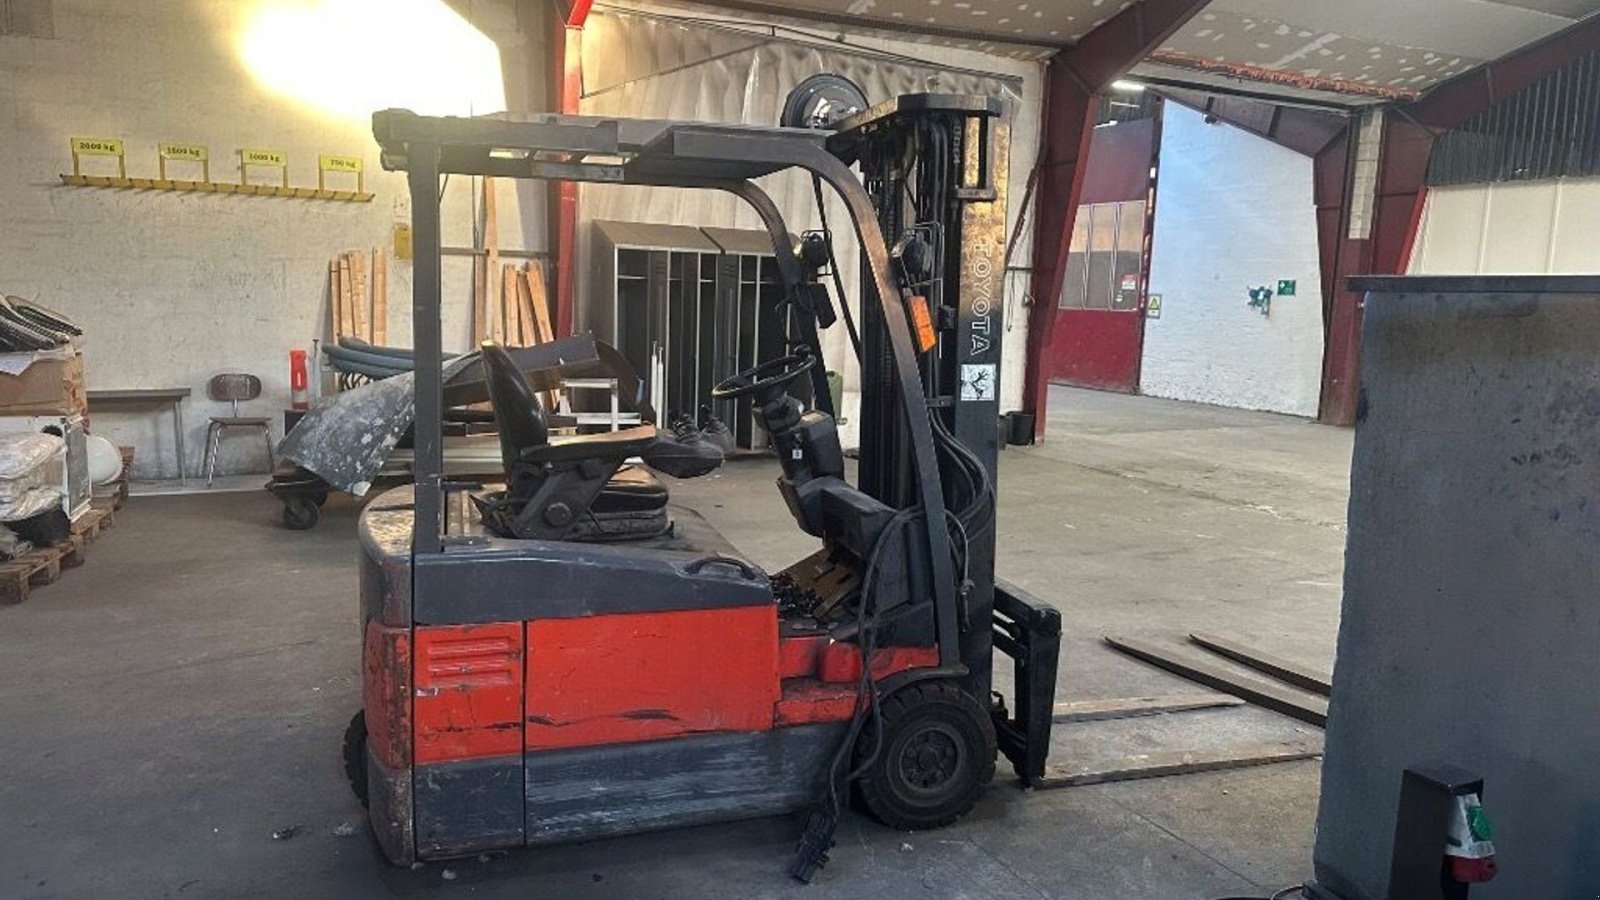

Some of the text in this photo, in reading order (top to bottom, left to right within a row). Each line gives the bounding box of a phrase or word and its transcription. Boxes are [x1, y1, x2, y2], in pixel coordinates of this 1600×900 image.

[103, 143, 116, 152] kg
[189, 148, 200, 157] kg
[270, 154, 280, 163] kg
[971, 243, 992, 356] TOYOTA
